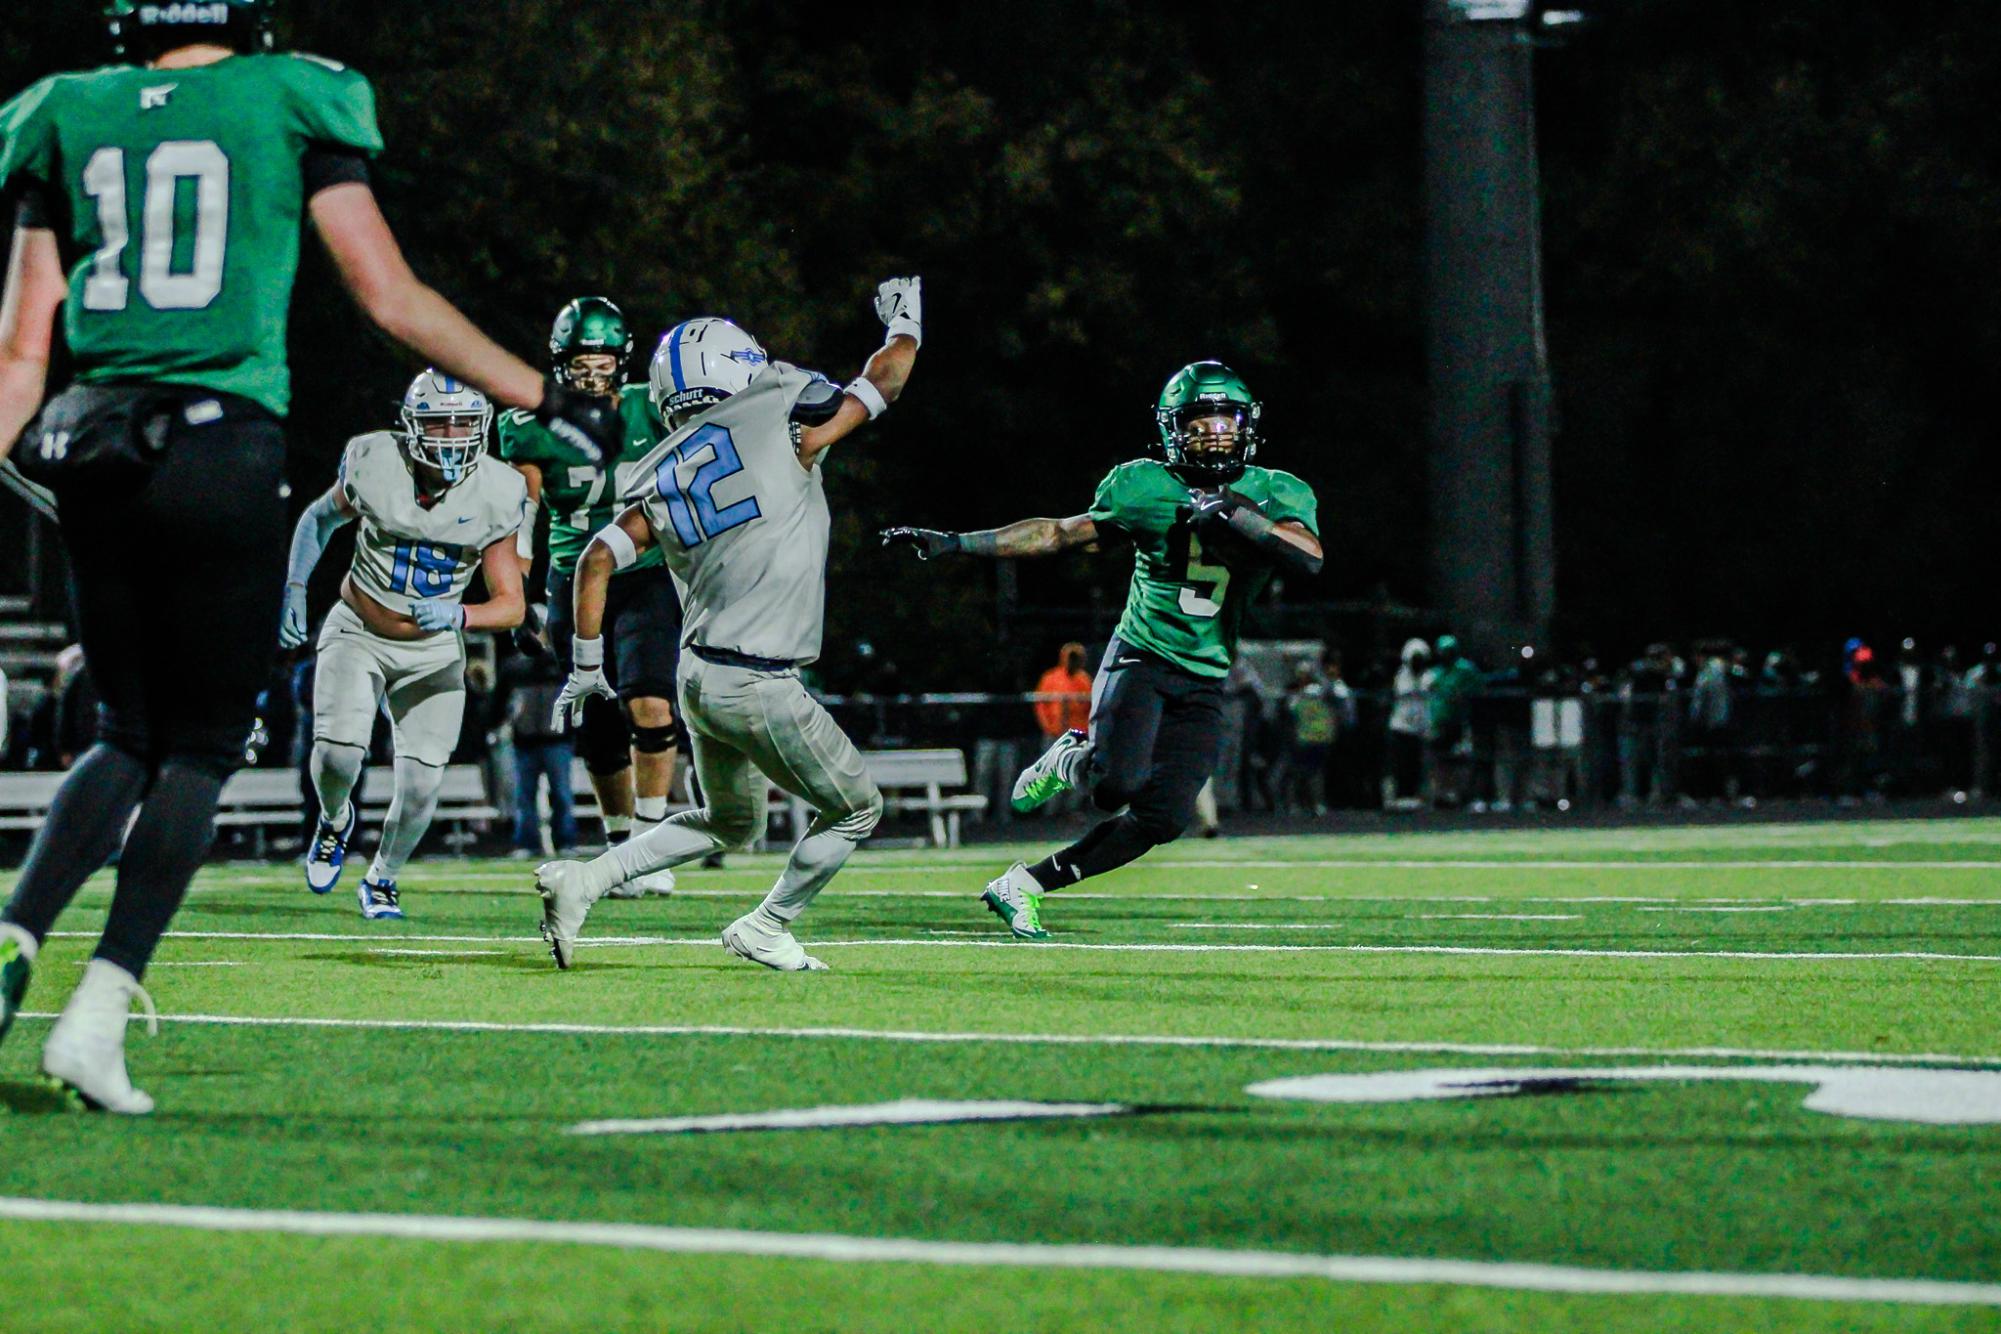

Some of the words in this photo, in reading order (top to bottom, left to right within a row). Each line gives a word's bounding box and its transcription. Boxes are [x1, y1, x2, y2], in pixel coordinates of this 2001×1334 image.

[83, 140, 229, 310] 10
[655, 421, 762, 550] 12
[389, 540, 462, 598] 18
[1178, 530, 1231, 618] 5
